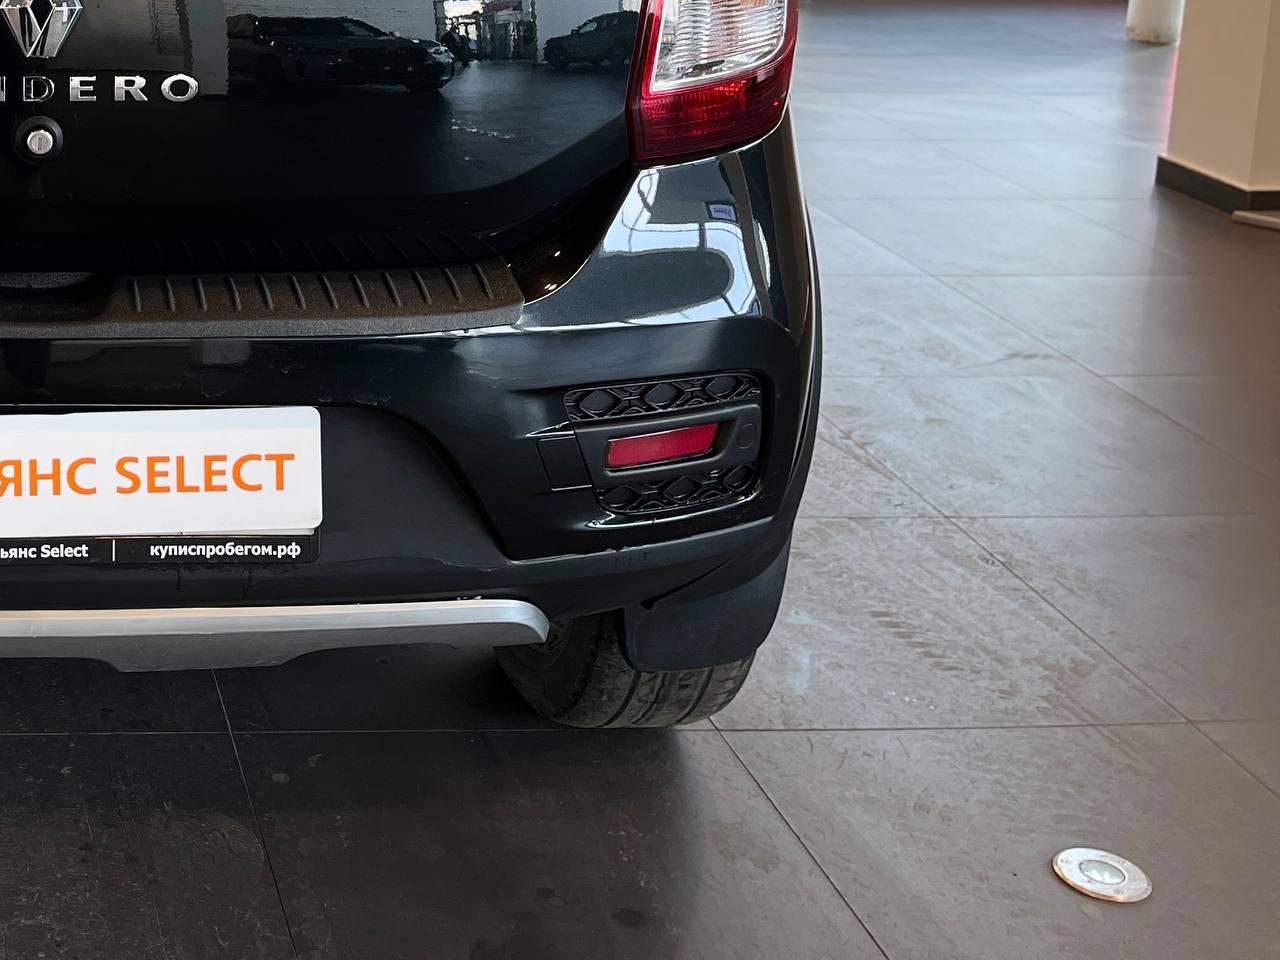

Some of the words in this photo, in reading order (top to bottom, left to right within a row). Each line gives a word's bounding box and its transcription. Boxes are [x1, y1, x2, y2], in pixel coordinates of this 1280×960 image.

[115, 453, 296, 494] SELECT
[40, 543, 89, 558] Select
[150, 542, 301, 559] куписпробегом.рф
